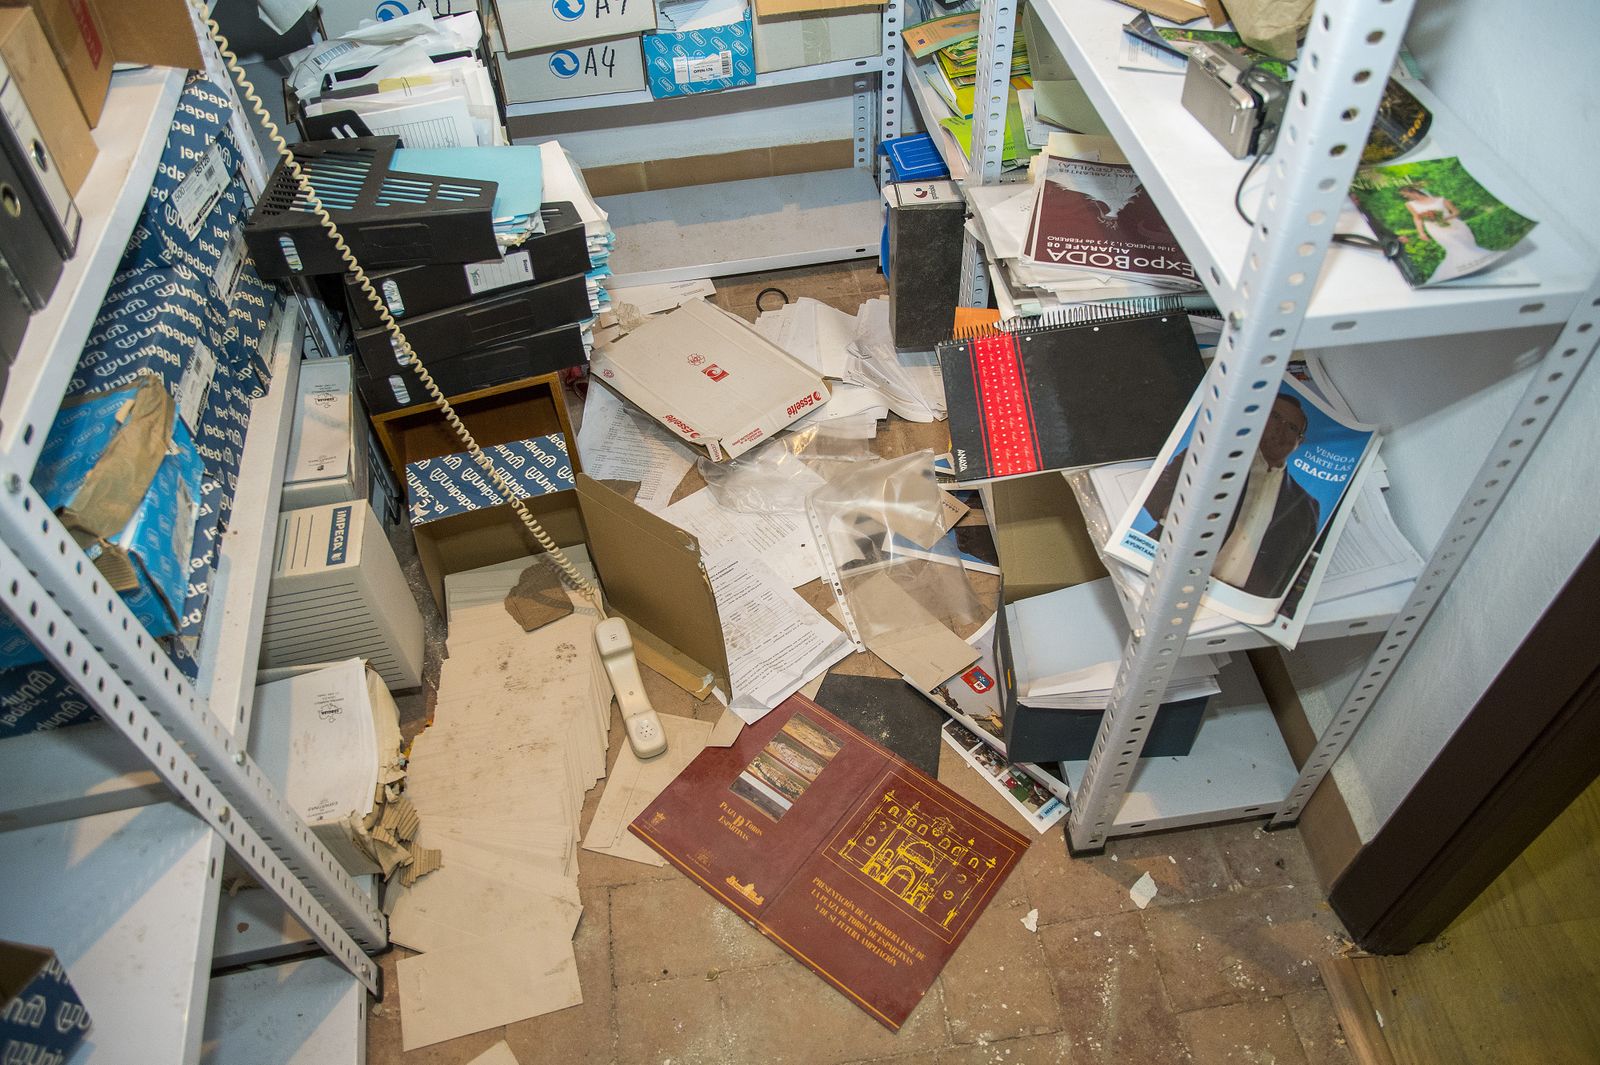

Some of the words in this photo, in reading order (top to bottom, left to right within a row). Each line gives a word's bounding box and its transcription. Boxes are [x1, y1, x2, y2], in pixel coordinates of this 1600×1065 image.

[584, 46, 617, 79] A4
[1065, 243, 1130, 254] ALJARAFE
[787, 394, 814, 417] Esselte
[665, 414, 692, 434] Esselte
[1304, 451, 1333, 470] DARTE
[1335, 462, 1352, 471] LAS
[1315, 446, 1348, 463] VENGO
[1293, 458, 1348, 482] GRACIAS
[333, 510, 347, 551] IMPEGA
